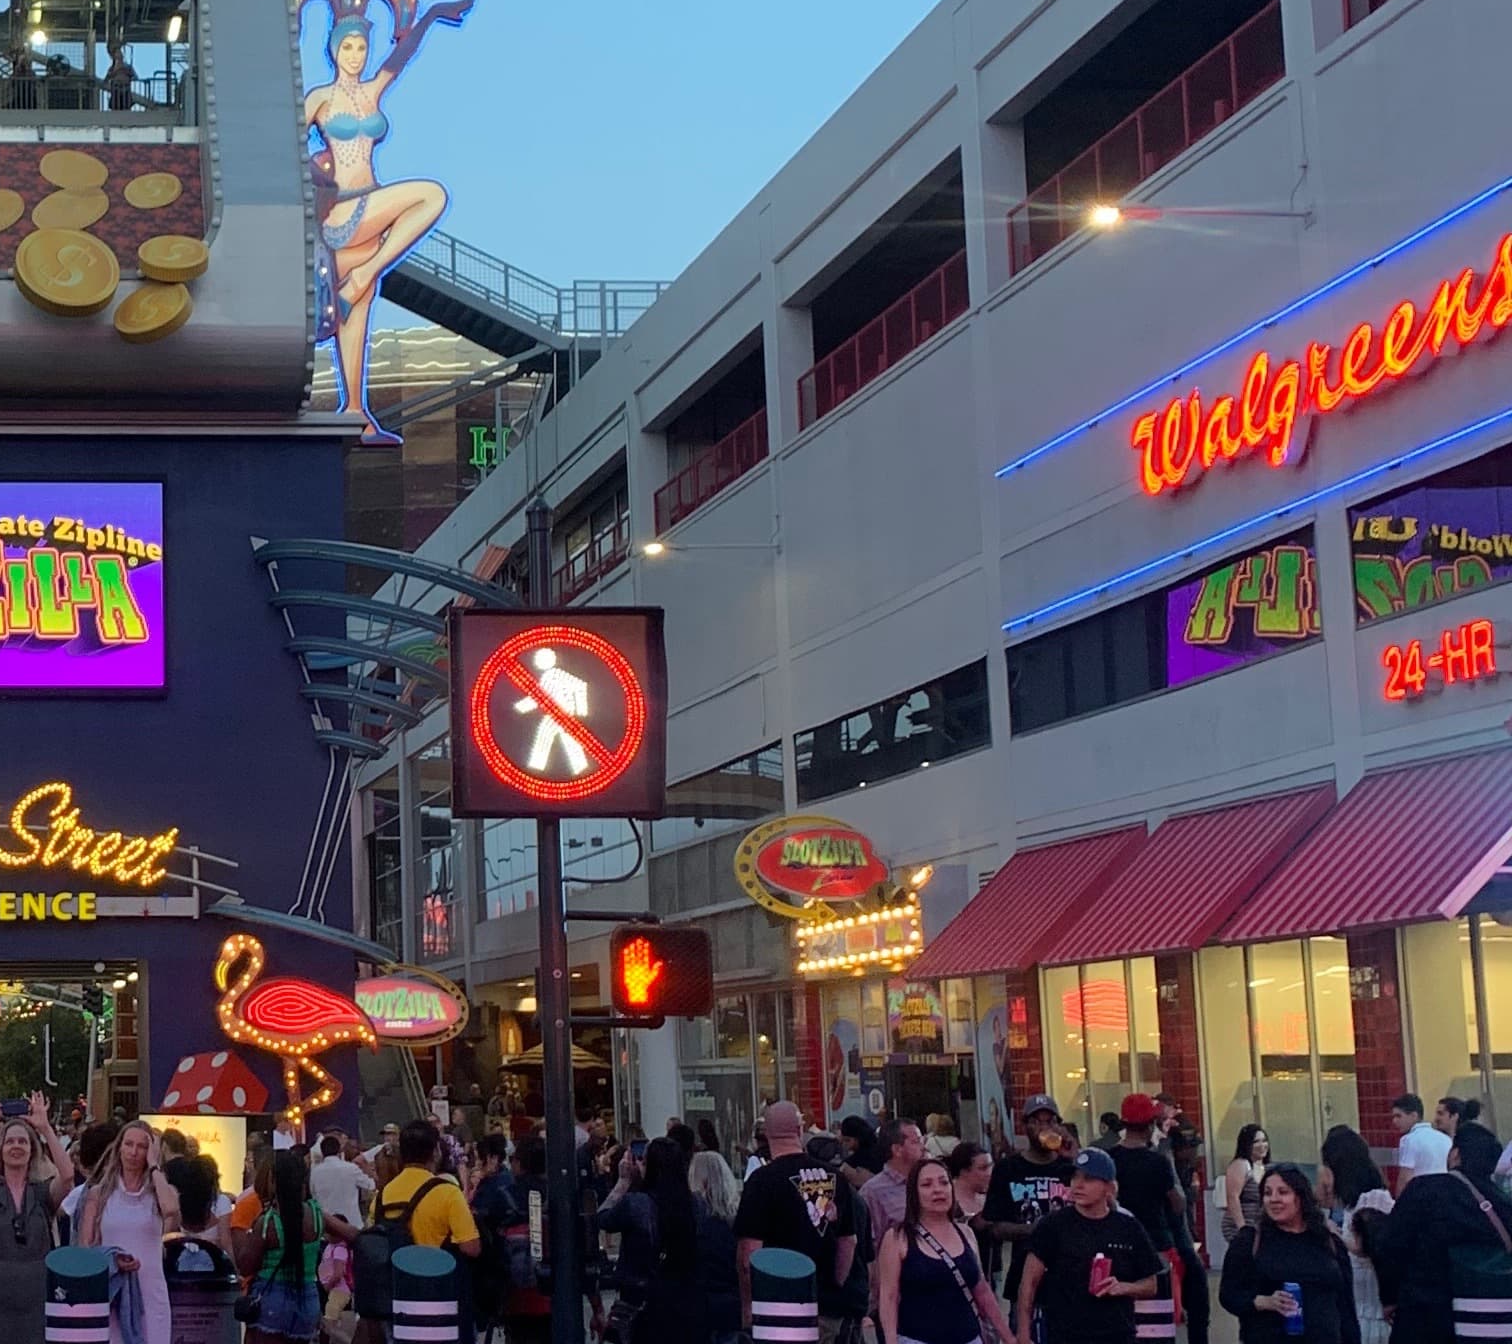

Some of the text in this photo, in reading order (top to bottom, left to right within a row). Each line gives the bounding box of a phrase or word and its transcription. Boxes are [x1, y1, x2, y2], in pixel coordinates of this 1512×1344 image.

[1133, 232, 1512, 496] Walgreens
[53, 515, 163, 562] Zipline
[1382, 617, 1497, 702] 24-HR
[780, 834, 869, 867] SLOTZILLA
